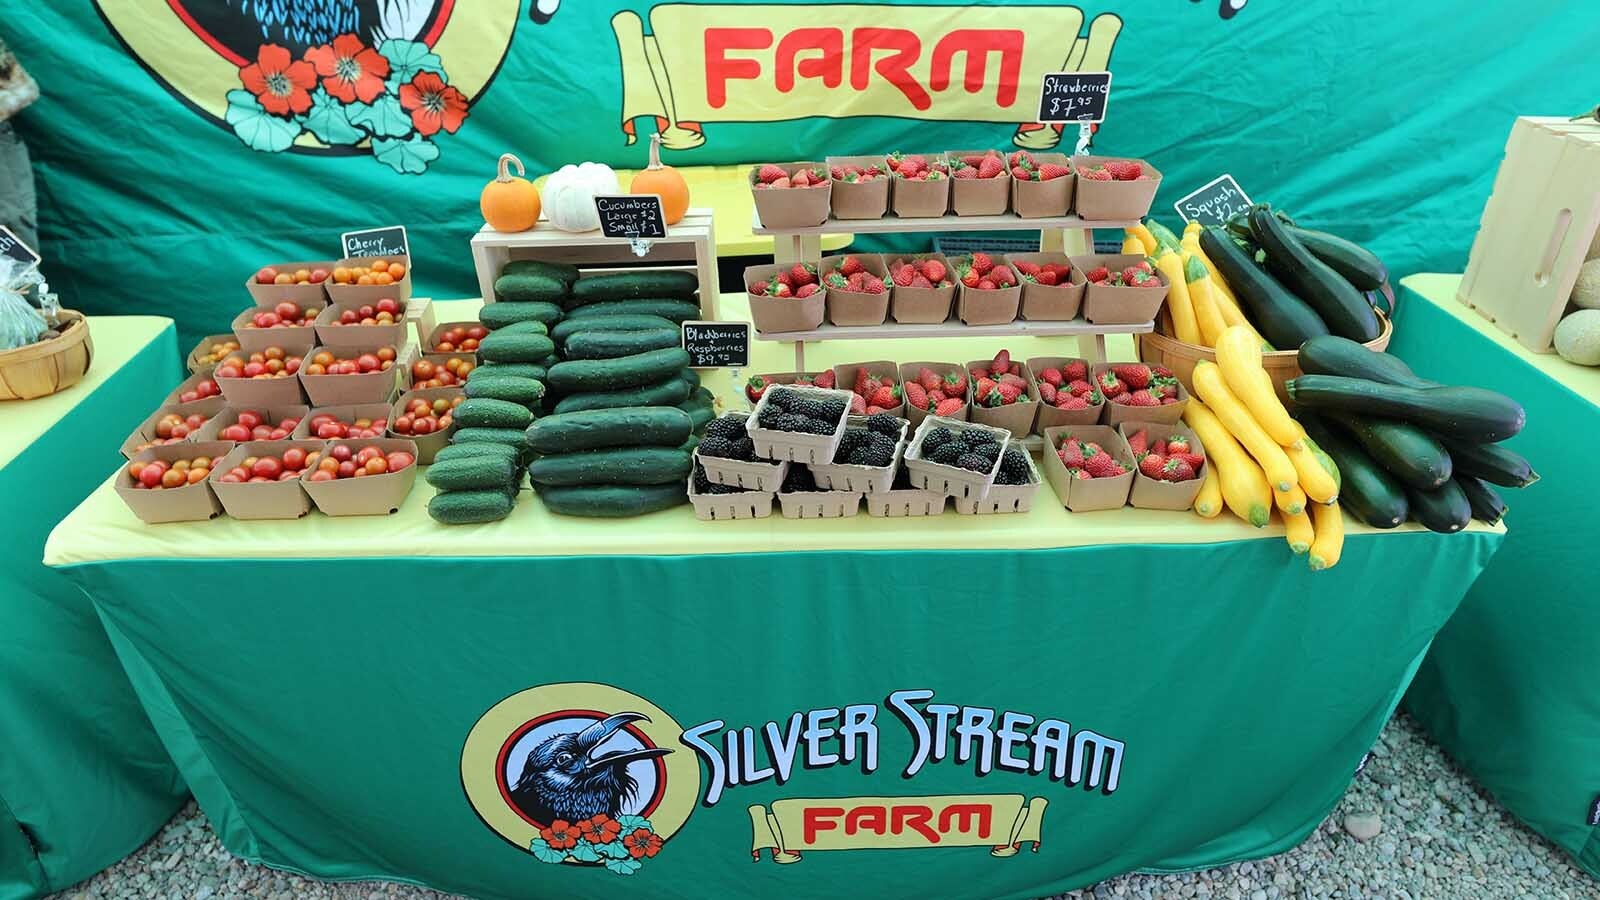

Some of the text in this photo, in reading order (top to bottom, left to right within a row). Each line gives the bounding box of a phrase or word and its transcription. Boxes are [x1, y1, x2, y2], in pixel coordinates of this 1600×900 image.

[704, 28, 1024, 111] FARM
[598, 199, 657, 211] Cucumbers
[1185, 186, 1236, 218] Squash
[607, 210, 656, 223] Large $2
[609, 220, 661, 235] Small $1
[347, 237, 384, 252] Cherry
[686, 327, 746, 341] Blackberries
[687, 343, 745, 354] Raspberries
[680, 688, 1126, 808] SILVER STREAM
[803, 804, 993, 844] FARM
